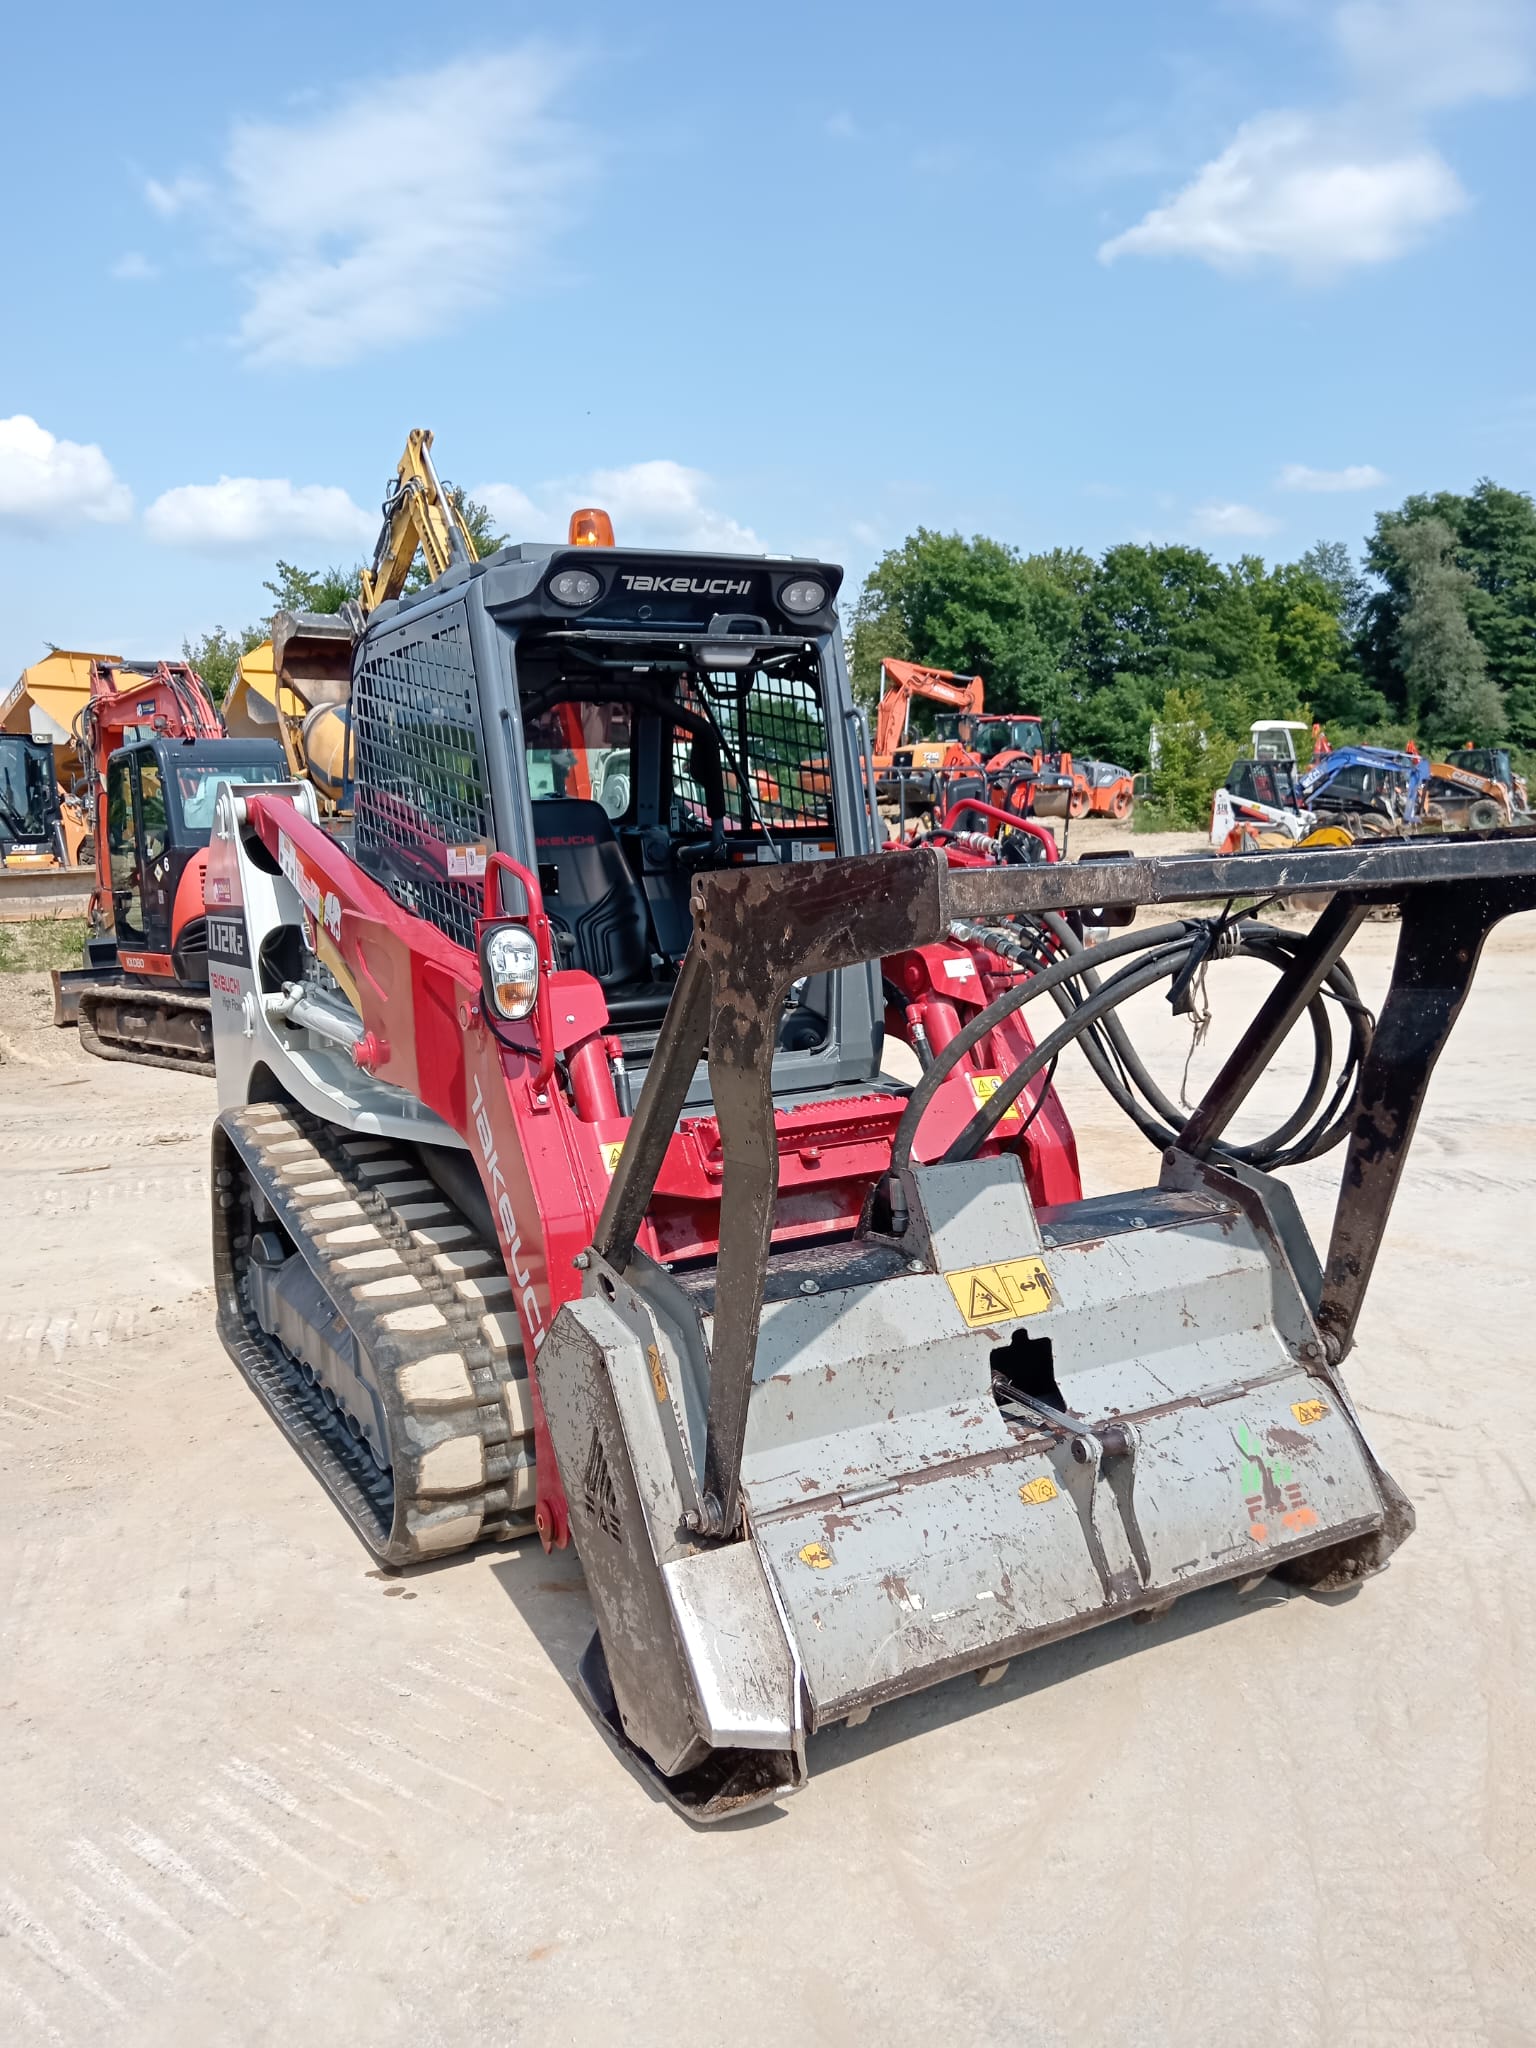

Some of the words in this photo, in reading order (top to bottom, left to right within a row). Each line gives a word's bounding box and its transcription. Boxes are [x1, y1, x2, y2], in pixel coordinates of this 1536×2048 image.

[621, 575, 751, 595] TAKEUCHI
[1452, 771, 1485, 788] CASE
[163, 856, 170, 872] 6
